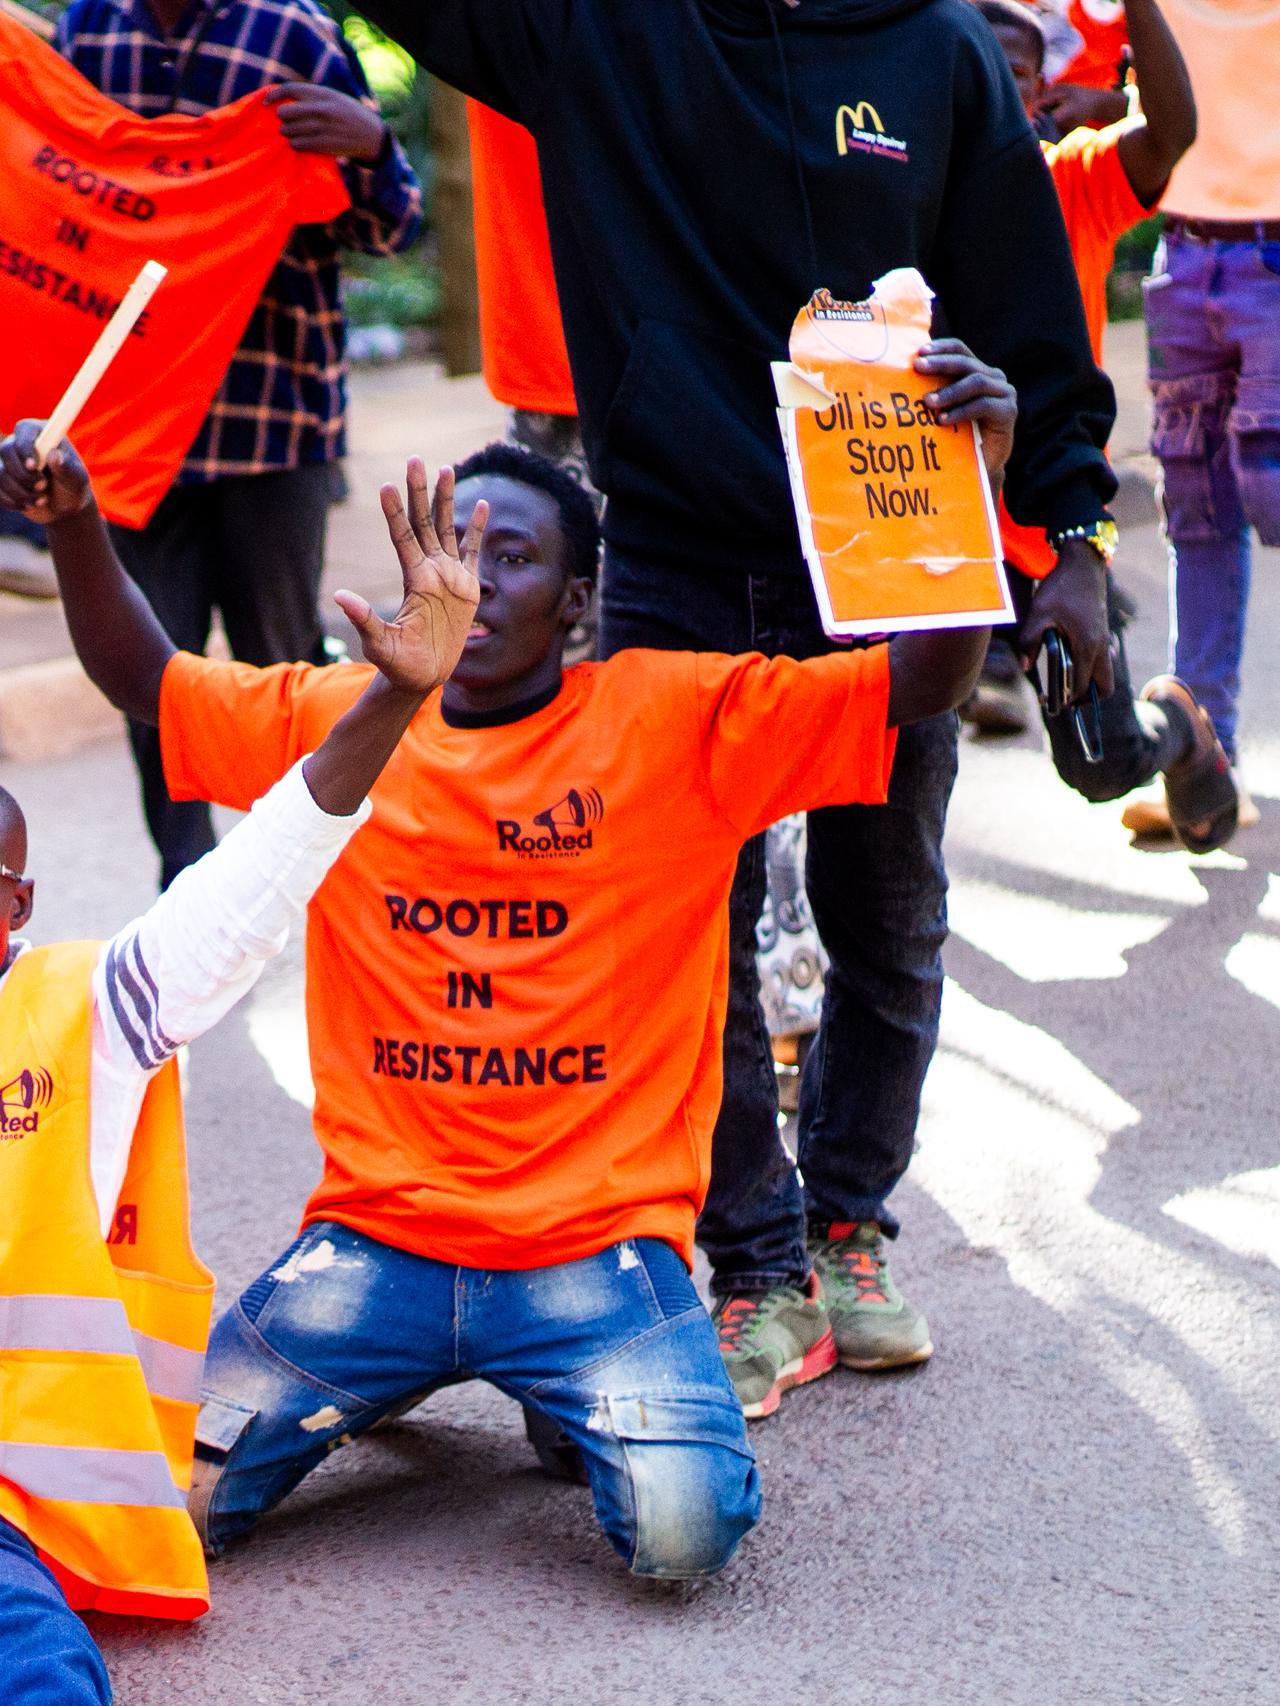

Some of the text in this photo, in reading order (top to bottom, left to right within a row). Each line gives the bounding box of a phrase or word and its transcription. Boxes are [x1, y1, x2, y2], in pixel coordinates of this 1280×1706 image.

[33, 146, 156, 221] ROOTED
[56, 217, 90, 252] IN
[858, 391, 888, 430] is
[847, 435, 941, 482] Stop It
[865, 482, 938, 519] Now.
[496, 819, 593, 852] Rooted
[384, 895, 569, 938] ROOTED
[447, 971, 493, 1009] IN
[373, 1036, 607, 1086] RESISTANCE
